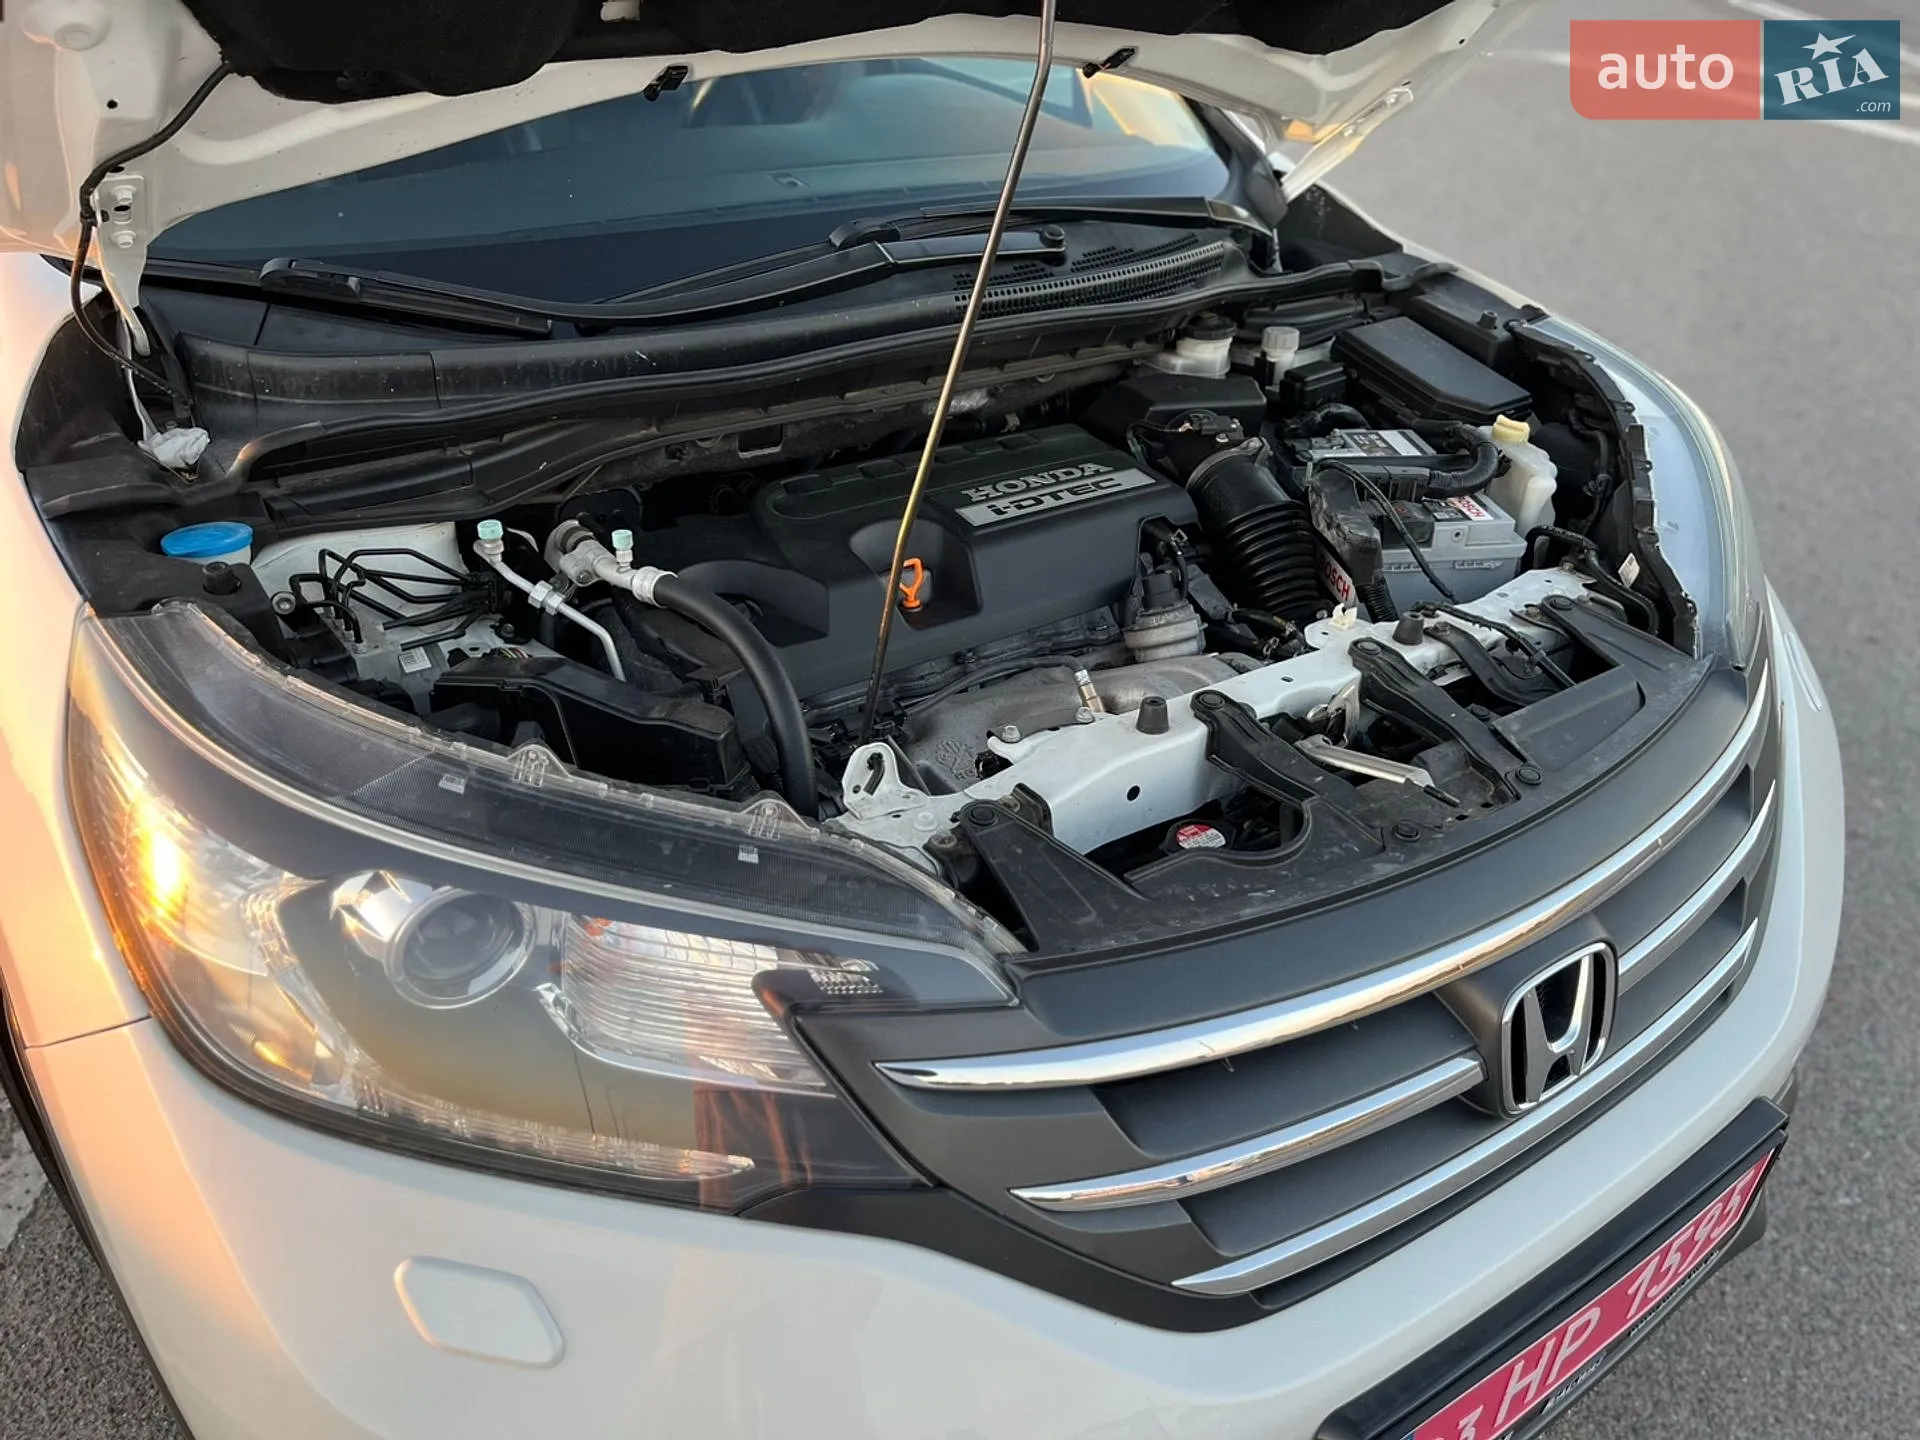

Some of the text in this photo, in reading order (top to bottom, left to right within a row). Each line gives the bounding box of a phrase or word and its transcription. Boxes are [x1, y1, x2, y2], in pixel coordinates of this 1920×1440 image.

[961, 462, 1114, 502] HONDA
[1493, 1306, 1601, 1428] HP
[1626, 1168, 1756, 1320] 1595
